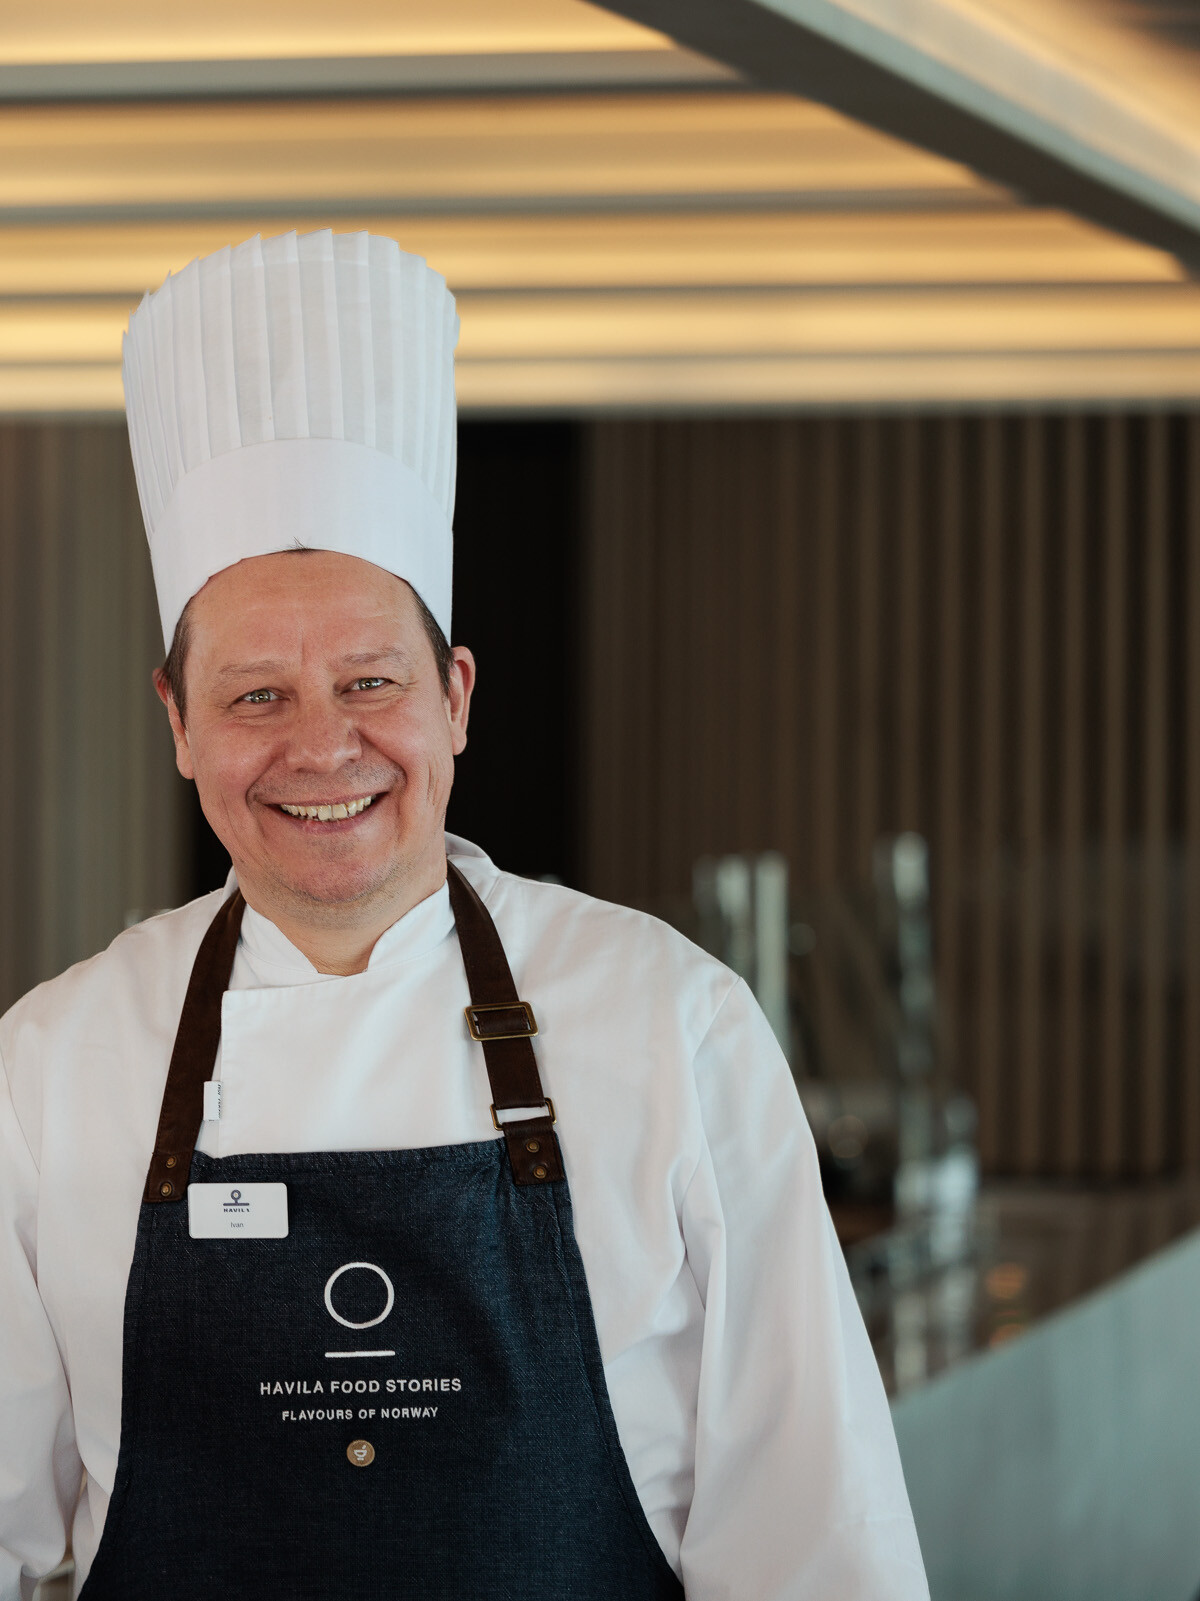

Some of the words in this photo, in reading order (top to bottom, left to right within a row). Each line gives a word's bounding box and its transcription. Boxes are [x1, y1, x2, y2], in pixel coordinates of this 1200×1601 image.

[260, 1380, 324, 1396] HAVILA
[330, 1379, 380, 1394] FOOD
[385, 1377, 462, 1393] STORIES
[281, 1409, 353, 1421] FLAVOURS
[358, 1408, 376, 1420] OF
[380, 1406, 439, 1419] NORWAY
